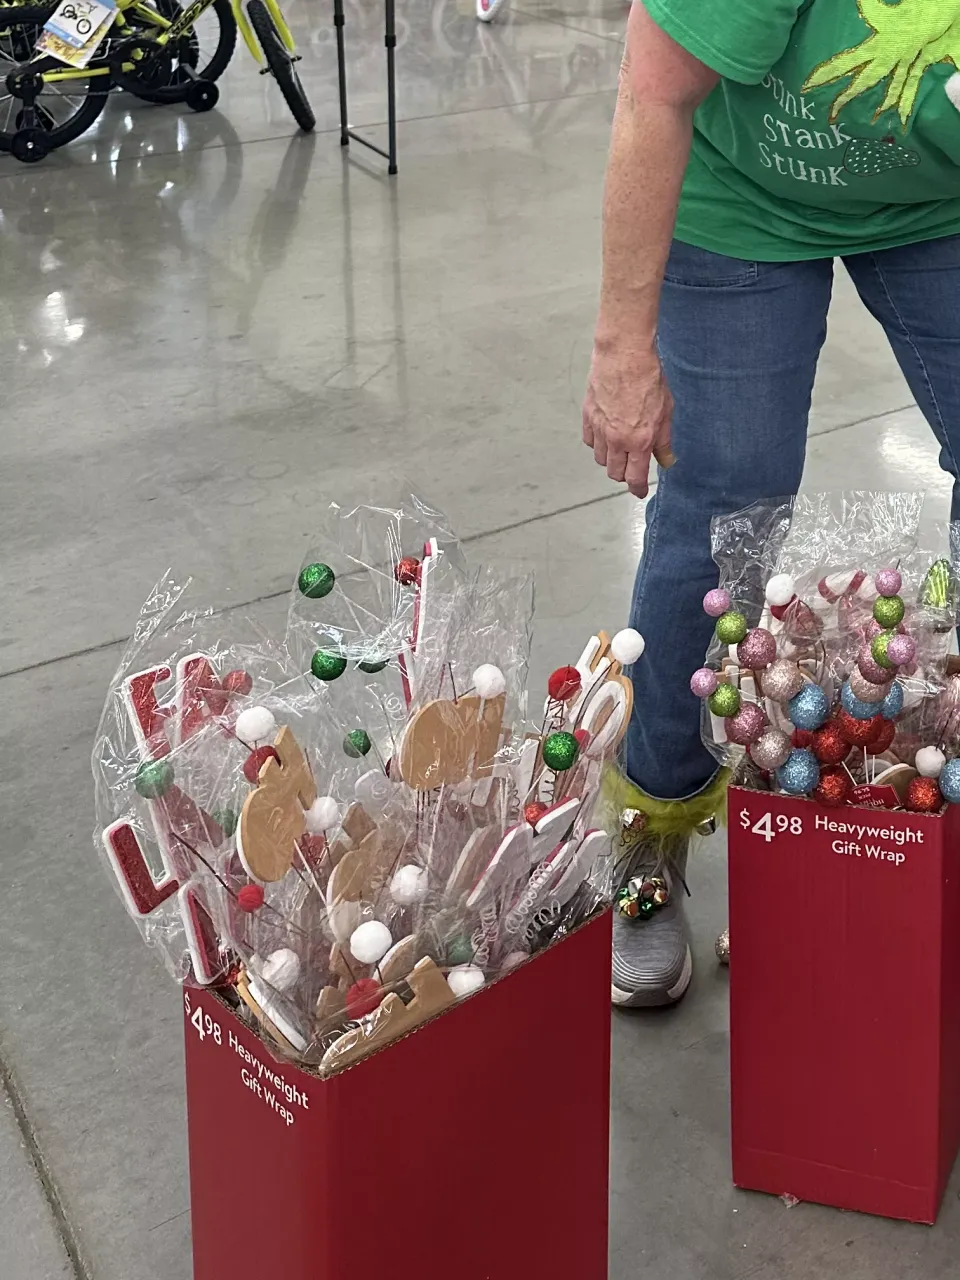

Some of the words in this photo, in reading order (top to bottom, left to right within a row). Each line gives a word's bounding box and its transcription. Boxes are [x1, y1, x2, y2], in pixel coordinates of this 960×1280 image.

[815, 815, 924, 846] Heavyweight
[832, 840, 862, 858] Gift
[865, 844, 906, 865] Wrap
[229, 1030, 309, 1110] Heavyweight
[241, 1068, 262, 1098] Gift
[263, 1086, 294, 1127] Wrap
